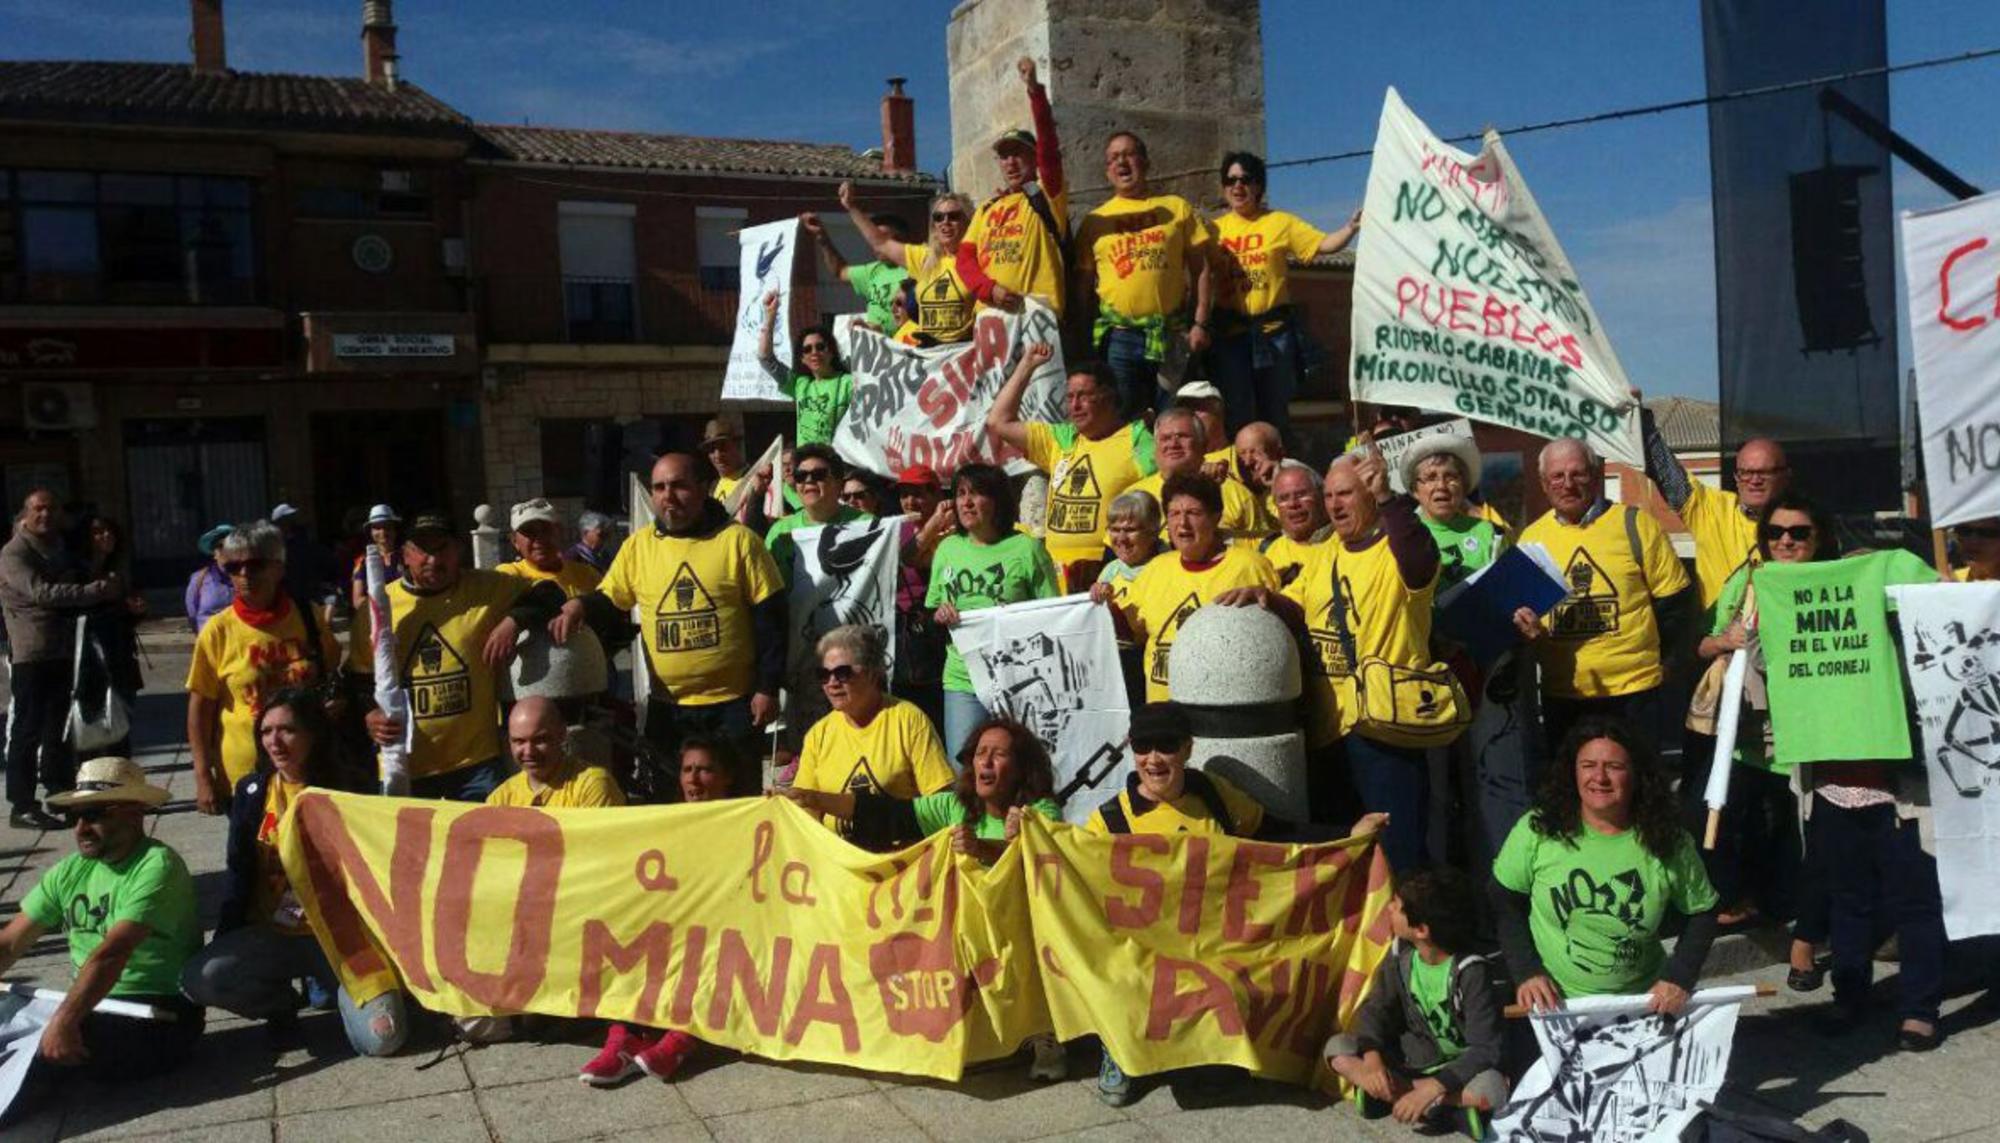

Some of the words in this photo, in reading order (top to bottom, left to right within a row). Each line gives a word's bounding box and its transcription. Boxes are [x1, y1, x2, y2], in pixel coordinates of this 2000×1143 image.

[1393, 180, 1447, 223] NO
[1222, 233, 1263, 256] NO
[1396, 276, 1584, 369] PUEBLOS
[1793, 588, 1813, 605] NO
[1820, 587, 1830, 603] A
[1834, 585, 1854, 602] LA
[1796, 607, 1857, 634] MINA
[659, 621, 680, 648] NO
[1789, 639, 1807, 653] EN
[1812, 637, 1828, 652] EL
[1832, 633, 1868, 651] VALLE
[1788, 662, 1813, 678] DEL
[294, 791, 566, 1013] NO
[748, 820, 817, 907] la
[577, 917, 861, 1053] MINA
[887, 970, 957, 1011] STOP
